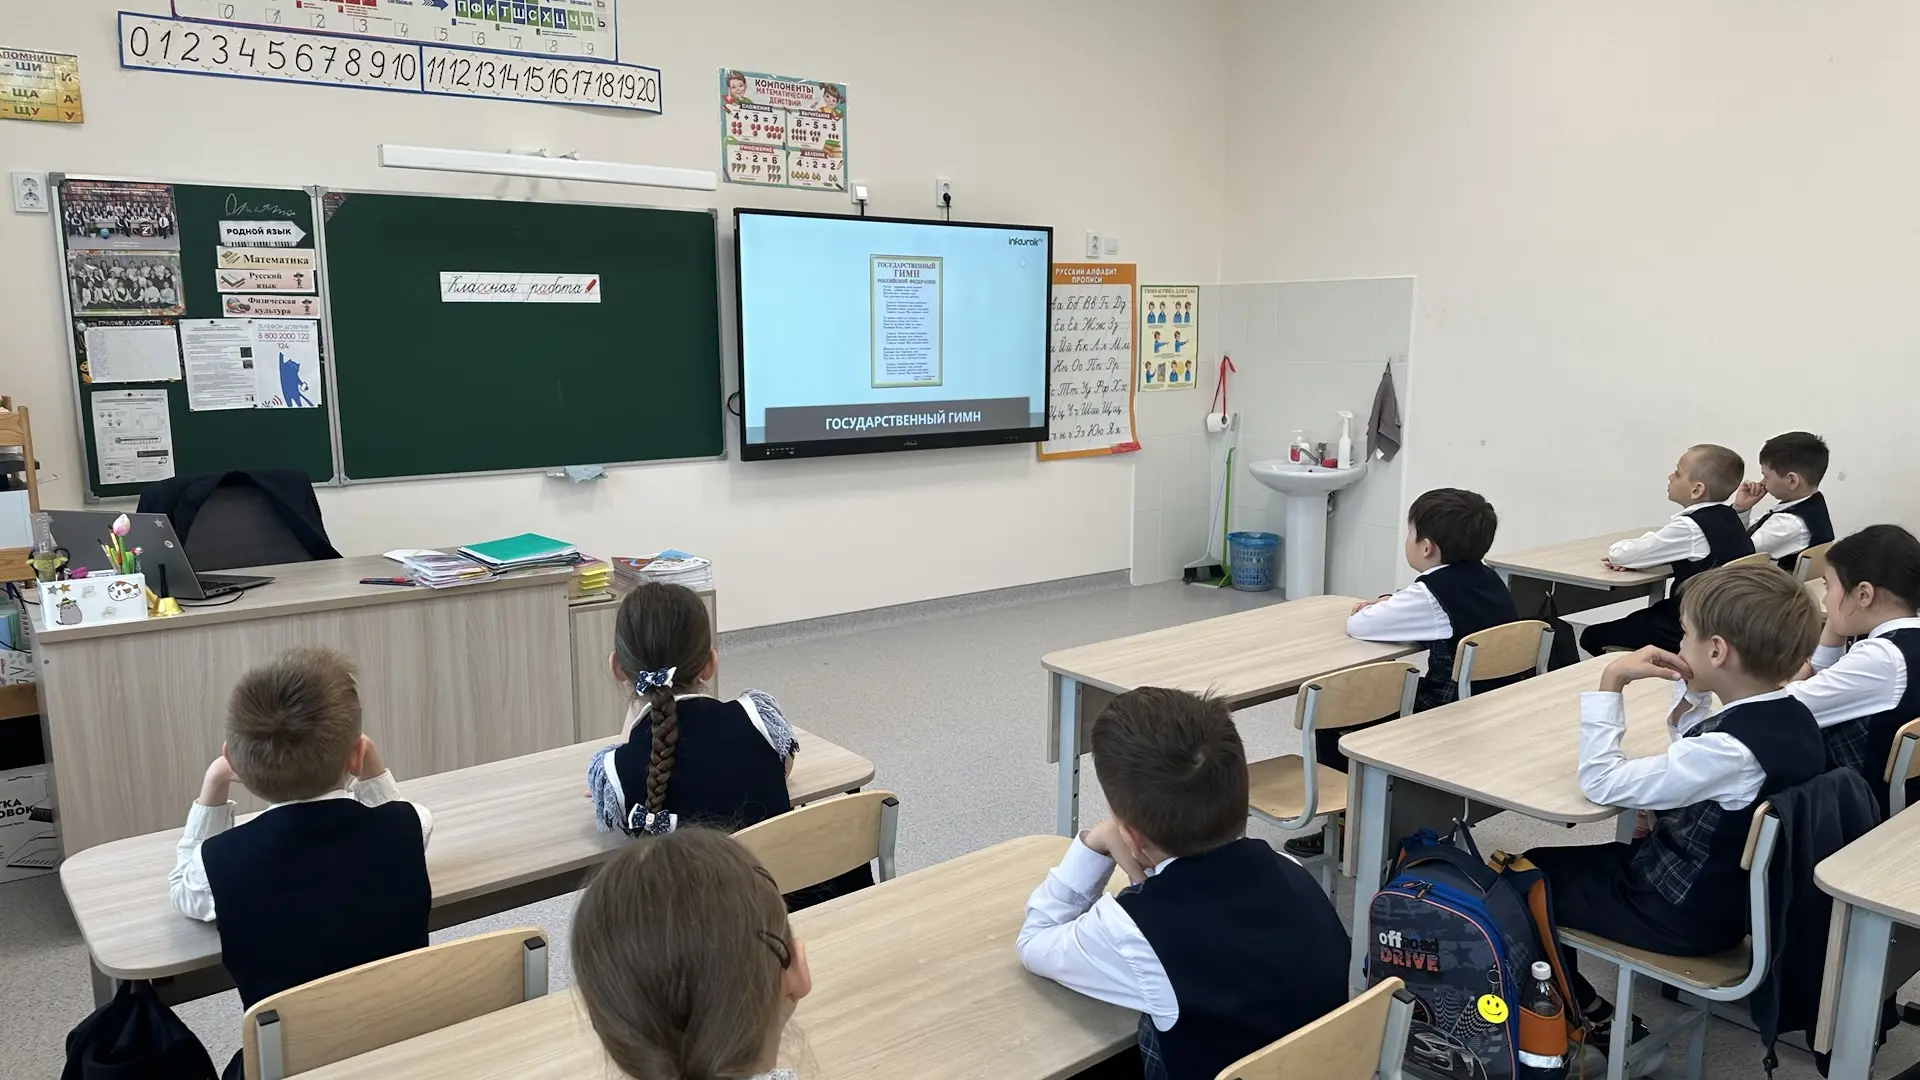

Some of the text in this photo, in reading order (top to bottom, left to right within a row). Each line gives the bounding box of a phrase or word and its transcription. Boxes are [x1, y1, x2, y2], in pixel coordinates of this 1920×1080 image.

[458, 0, 594, 28] П Ф К Т Ш С Х Ц Ч Щ
[224, 4, 594, 55] 0 1 2 3 4 5 6 7 8 9
[16, 62, 42, 72] ШИ
[130, 26, 656, 102] 0 1 2 3 4 5 6 7 8 9 10 11 12 13 14 15 16 17 18 19 20
[756, 80, 814, 93] КОМПОНЕНТЫ
[12, 88, 39, 99] ЩА
[756, 88, 813, 100] МАТЕМАТИЧЕСКИХ
[64, 95, 74, 104] А
[769, 97, 802, 106] ДЕЙСТВИЙ
[14, 106, 40, 116] ЩУ
[742, 104, 770, 112] СЛОЖЕНИЕ
[65, 112, 75, 120] У
[801, 111, 830, 119] ВЫЧИТАНИЕ
[772, 156, 778, 164] 6
[226, 226, 264, 235] РОДНОЙ
[244, 254, 309, 264] Математика
[249, 272, 282, 280] Русский
[894, 270, 920, 278] ГИМН
[449, 276, 584, 300] Классная работа
[248, 296, 296, 304] Физическая
[1082, 316, 1106, 330] Жж
[1075, 338, 1088, 352] Кк
[1110, 337, 1130, 350] Мм
[1054, 357, 1120, 374] Нн Оо Пп Рр
[826, 410, 981, 431] ГОСУДАРСТВЕННЫЙ ГИМН
[0, 798, 22, 808] КА
[1380, 948, 1440, 972] DRIVE
